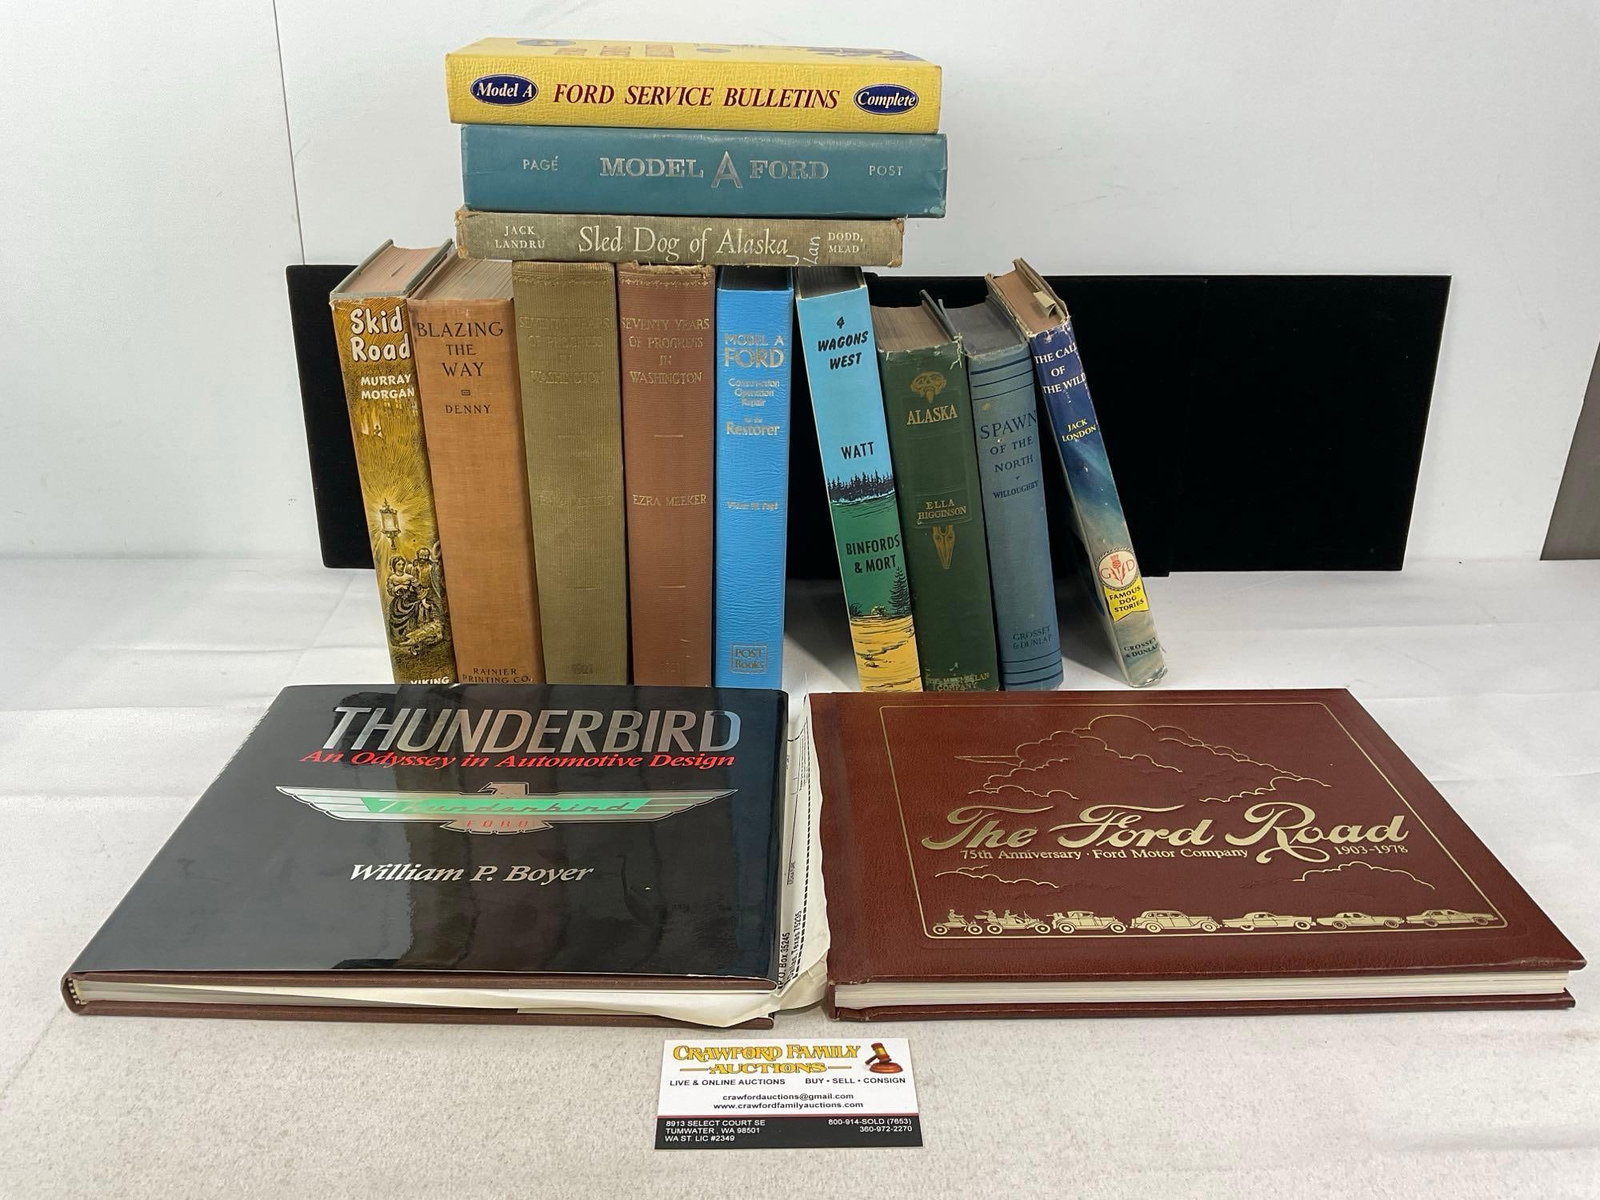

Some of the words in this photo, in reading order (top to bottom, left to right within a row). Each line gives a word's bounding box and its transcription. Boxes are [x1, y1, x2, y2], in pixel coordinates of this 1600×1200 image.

[476, 82, 518, 98] Model
[522, 82, 533, 98] A
[553, 83, 615, 104] FORD
[624, 86, 714, 106] SERVICE
[723, 87, 840, 109] BULLETINS
[857, 91, 916, 109] Complete
[522, 155, 559, 172] PAGÉ
[599, 157, 703, 178] MODEL
[710, 151, 743, 189] A
[749, 160, 829, 180] FORD
[869, 164, 904, 177] POST
[504, 225, 535, 237] JACK
[828, 231, 864, 242] DODD,
[494, 239, 546, 250] LANDRU
[578, 224, 624, 254] Sled
[633, 226, 680, 263] Dog
[689, 227, 712, 262] of
[715, 228, 789, 256] Alaska
[828, 245, 860, 254] MEAD
[350, 306, 403, 335] Skid
[621, 318, 669, 330] SEVENTY
[675, 318, 710, 330] YEARS
[836, 316, 845, 329] 4
[416, 321, 504, 338] BLAZING
[648, 336, 704, 349] PROGRESS
[724, 333, 769, 347] MODEL
[774, 334, 785, 346] A
[817, 330, 869, 352] WAGONS
[350, 333, 411, 362] Road
[445, 344, 477, 356] THE
[1034, 352, 1055, 364] THE
[1055, 342, 1077, 359] CALL
[723, 347, 785, 368] FORD
[829, 351, 862, 370] WEST
[442, 362, 484, 377] WAY
[1051, 365, 1065, 377] OF
[360, 374, 412, 386] MURRAY
[629, 371, 703, 385] WASHINGTON
[1042, 383, 1062, 394] THE
[1062, 372, 1087, 390] WILD
[361, 387, 415, 400] MORGAN
[445, 404, 491, 414] DENNY
[906, 404, 958, 426] ALASKA
[725, 421, 780, 436] Restorer
[980, 410, 1037, 440] SPAWN
[1067, 418, 1088, 432] JACK
[1062, 424, 1097, 442] LONDON
[841, 441, 874, 460] WATT
[990, 444, 1006, 455] OF
[1012, 435, 1033, 450] THE
[994, 454, 1034, 473] NORTH
[992, 480, 1039, 499] WILLOUGHBY
[632, 495, 662, 507] EZRA
[666, 494, 707, 507] MEEKER
[926, 498, 955, 510] ELLA
[918, 505, 967, 520] HIGGINSON
[845, 533, 900, 556] BINFORDS
[854, 561, 863, 574] &
[866, 554, 897, 572] MORT
[1101, 567, 1112, 580] G
[1125, 558, 1136, 572] D
[1109, 585, 1141, 600] FAMOUS
[1114, 599, 1145, 613] STORIES
[1119, 595, 1137, 605] DOG
[1012, 625, 1050, 641] GROSSET
[1124, 637, 1156, 651] GROSSET
[735, 648, 763, 659] POST
[735, 659, 764, 669] Books
[462, 674, 509, 683] PRINTING
[472, 668, 517, 676] RAINIER
[322, 706, 742, 754] THUNDERBIRD
[299, 750, 345, 763] An
[351, 751, 457, 770] Odyssey
[460, 753, 490, 768] in
[495, 753, 643, 768] Automotive
[649, 752, 736, 770] Design
[466, 819, 529, 828] FORD
[921, 803, 1054, 849] The
[1048, 803, 1214, 848] Ford
[1224, 801, 1409, 864] Road
[959, 850, 993, 860] 75th
[998, 849, 1082, 861] Anniversary
[1094, 849, 1128, 859] Ford
[1131, 849, 1176, 859] Motor
[1180, 848, 1248, 859] Company
[1333, 844, 1409, 855] 1903-1978
[350, 863, 464, 882] William
[468, 865, 495, 882] P.
[503, 865, 594, 884] Boyer
[780, 932, 791, 953] 35245
[790, 931, 800, 955] Texas
[778, 954, 788, 968] Box
[672, 1044, 783, 1062] CRAWFORD
[786, 1044, 861, 1060] FAMILY
[709, 1062, 828, 1075] AUCTIONS
[669, 1079, 690, 1087] LIVE
[804, 1077, 824, 1085] BUY
[832, 1077, 856, 1085] SELL
[722, 1092, 854, 1102] crawfordauctions@gmail.com
[713, 1100, 864, 1110] www.crawfordfamilyauctions.com
[722, 1119, 753, 1127] COURT
[754, 1119, 766, 1127] SE
[828, 1118, 885, 1126] 800-914-SOLD
[860, 1125, 913, 1133] 360-972-2270
[695, 1134, 709, 1142] LIC
[710, 1134, 735, 1142] #2349
[721, 1127, 735, 1135] WA
